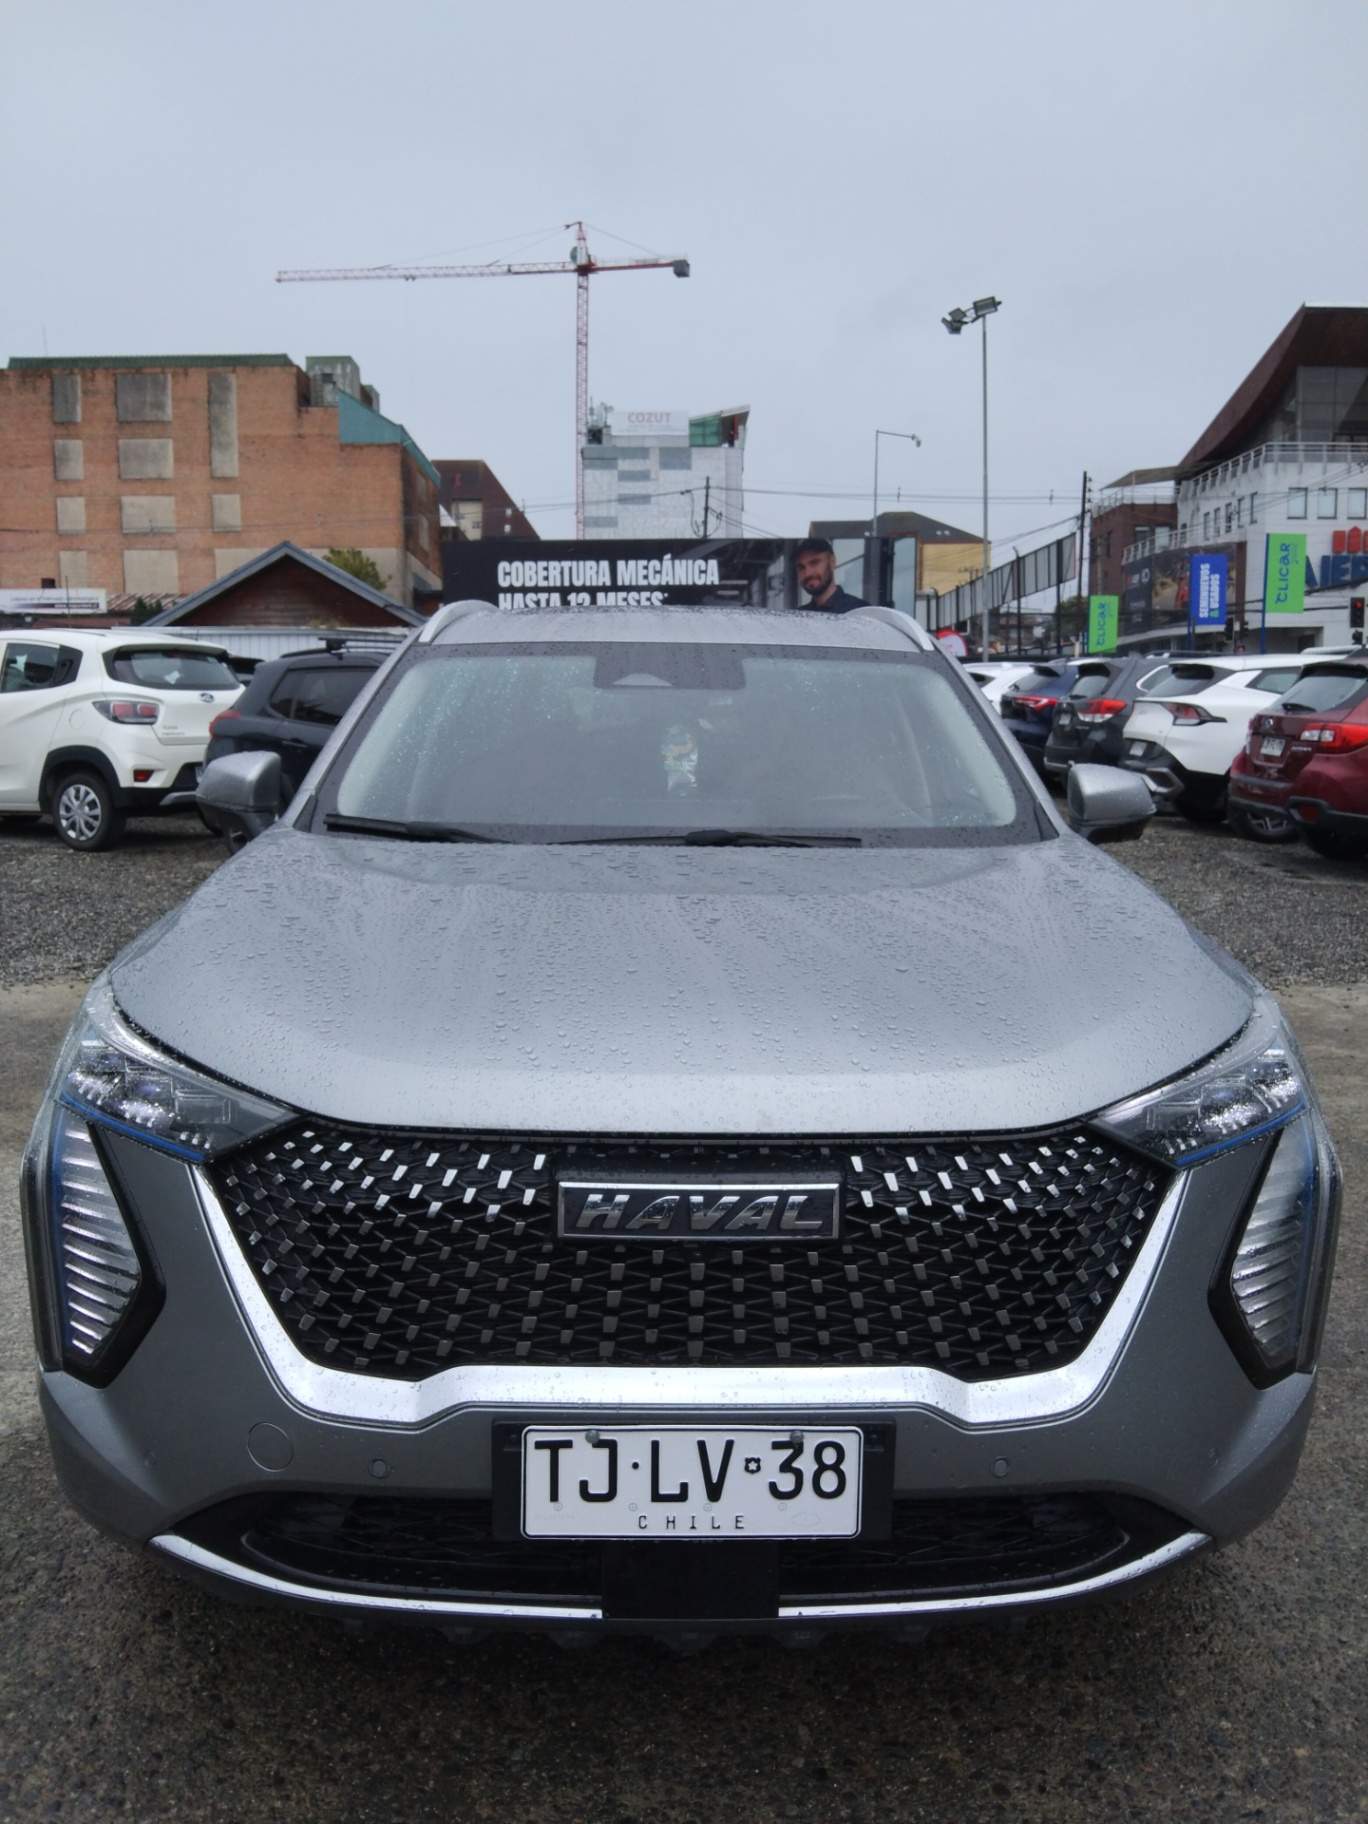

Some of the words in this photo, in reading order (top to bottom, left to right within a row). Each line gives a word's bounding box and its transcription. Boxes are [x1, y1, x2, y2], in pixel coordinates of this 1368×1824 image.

[497, 560, 611, 587] COBERTURA
[616, 553, 720, 586] MECÁNICA
[576, 1194, 823, 1231] HAVAL
[638, 1515, 745, 1530] CHILE
